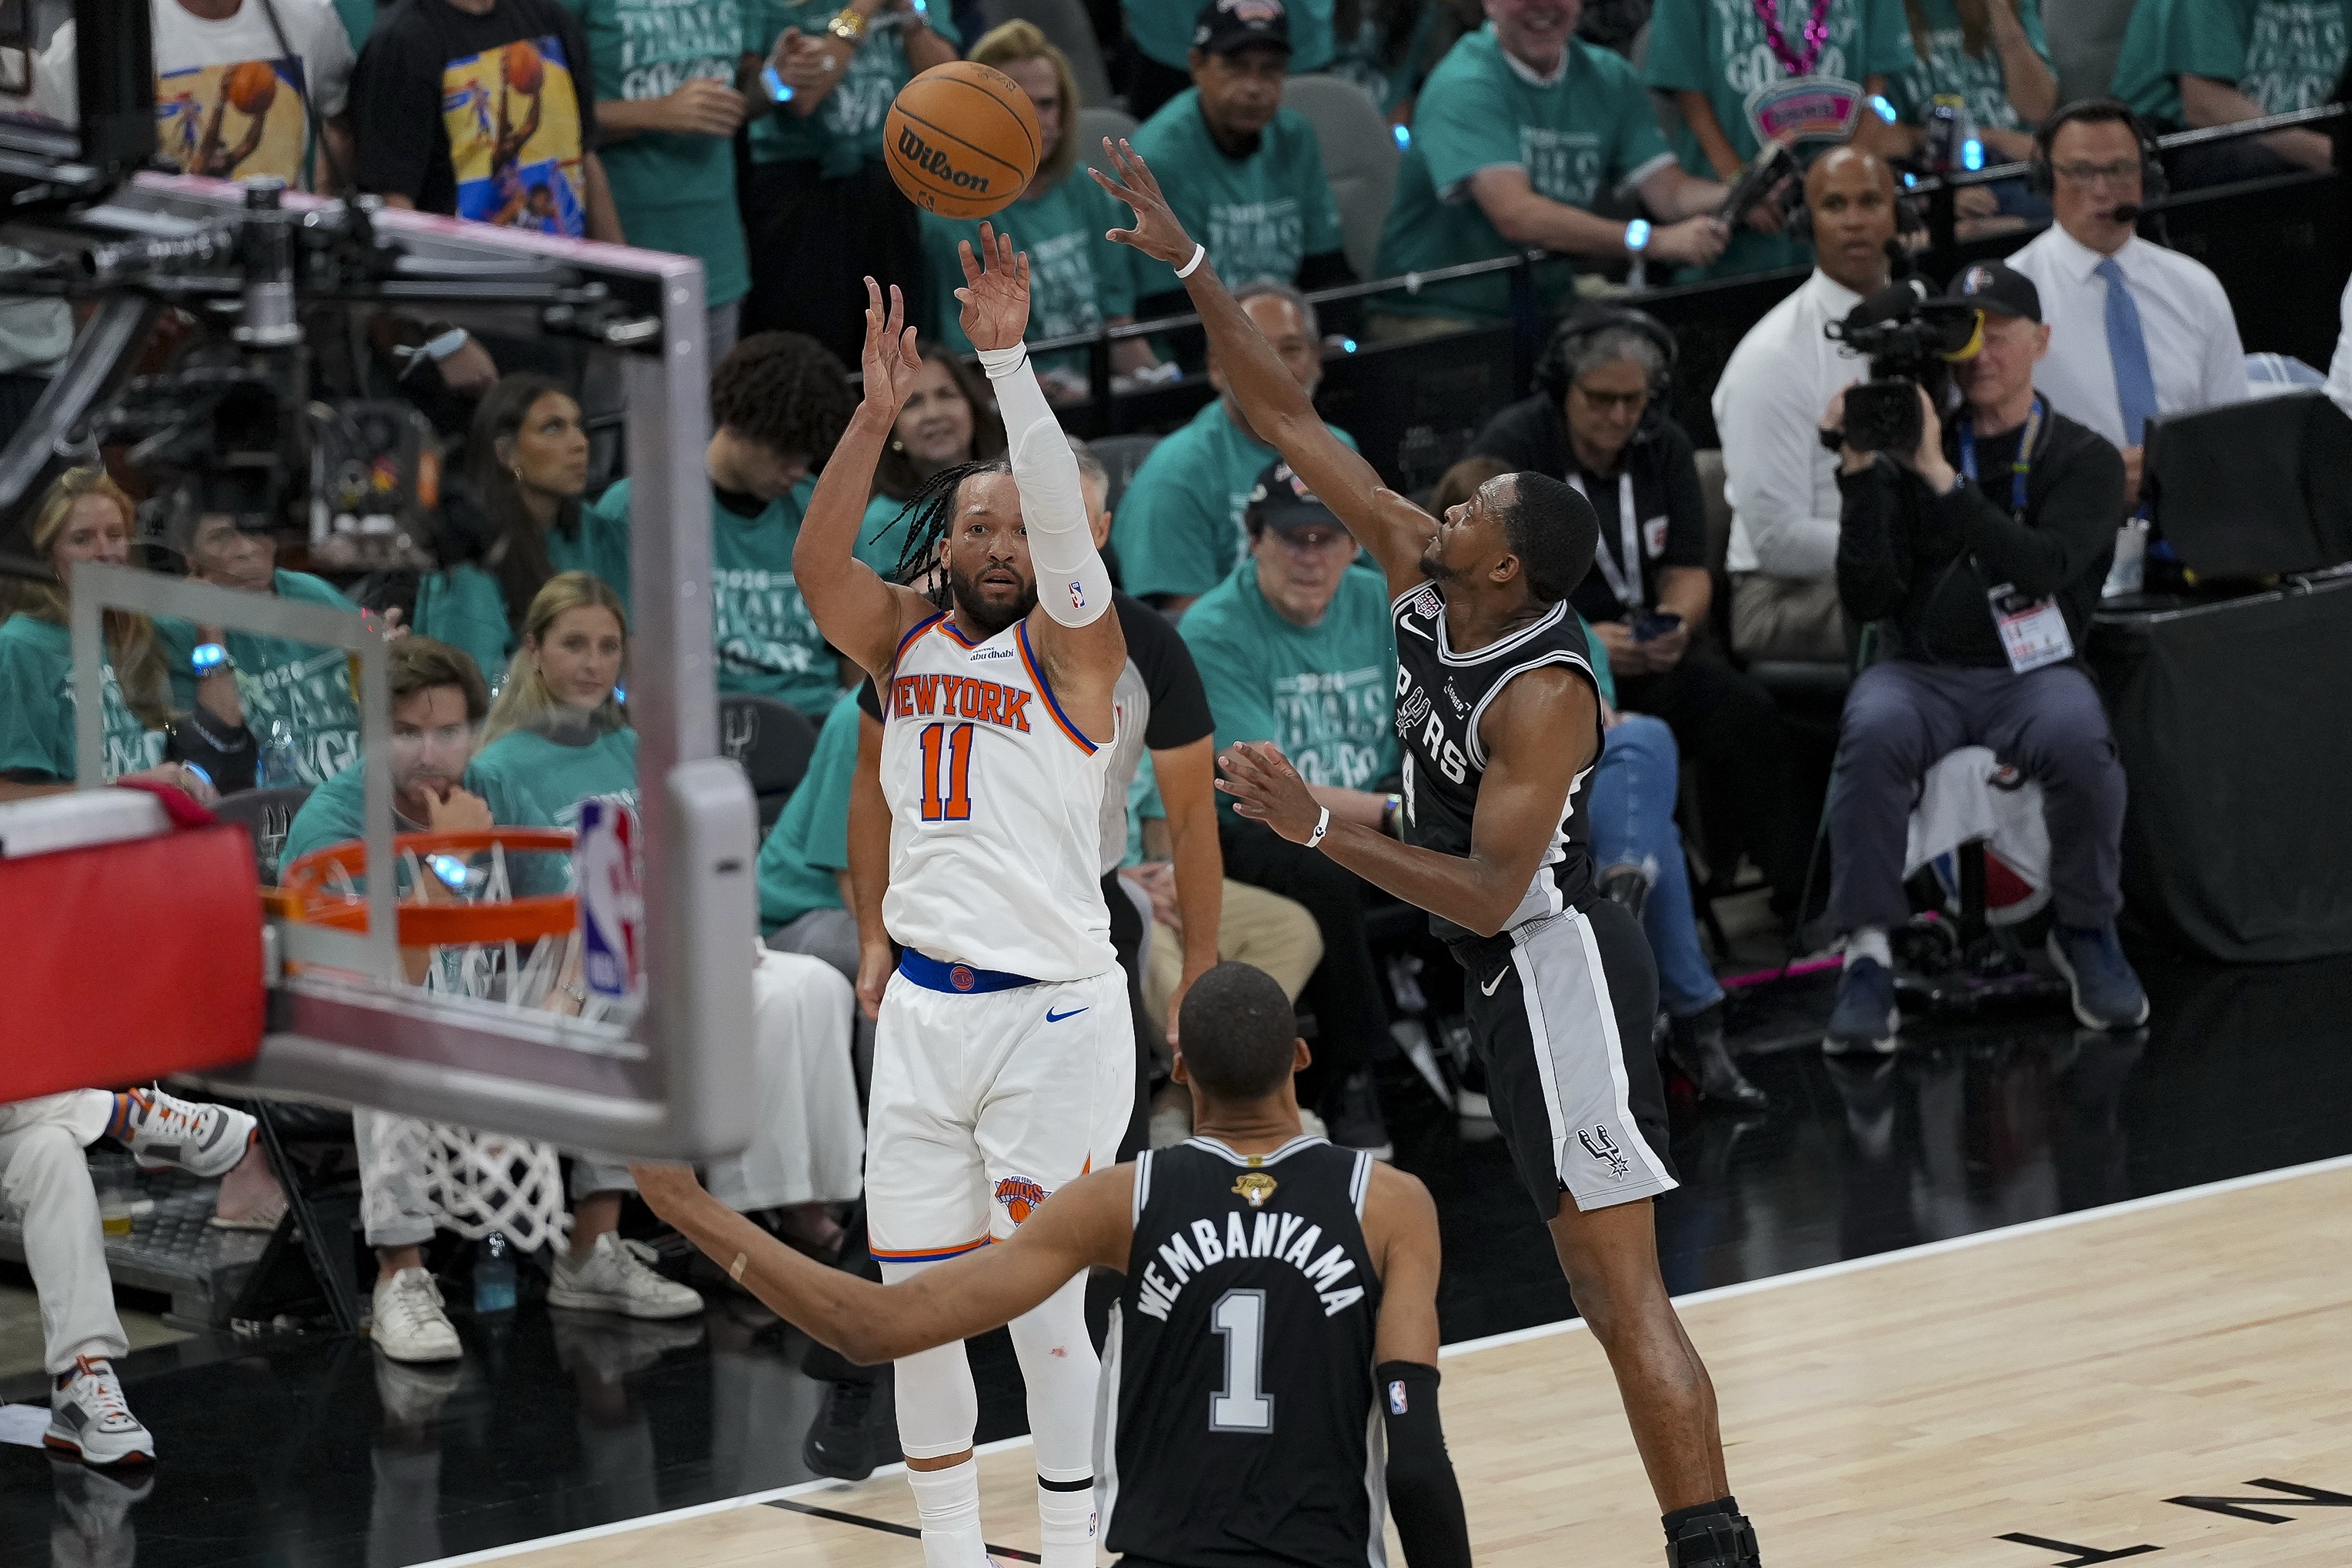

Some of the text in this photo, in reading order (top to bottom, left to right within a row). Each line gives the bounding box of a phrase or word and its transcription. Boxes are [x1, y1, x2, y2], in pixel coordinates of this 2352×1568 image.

[898, 123, 990, 193] Wilson
[988, 648, 1014, 659] dhabi
[939, 673, 1033, 736] YORK
[1447, 683, 1464, 712] LEDGER
[919, 722, 974, 822] 11
[995, 1178, 1046, 1205] KNICKS
[1137, 1211, 1366, 1323] WEMBANYAMA
[1209, 1288, 1275, 1435] 1
